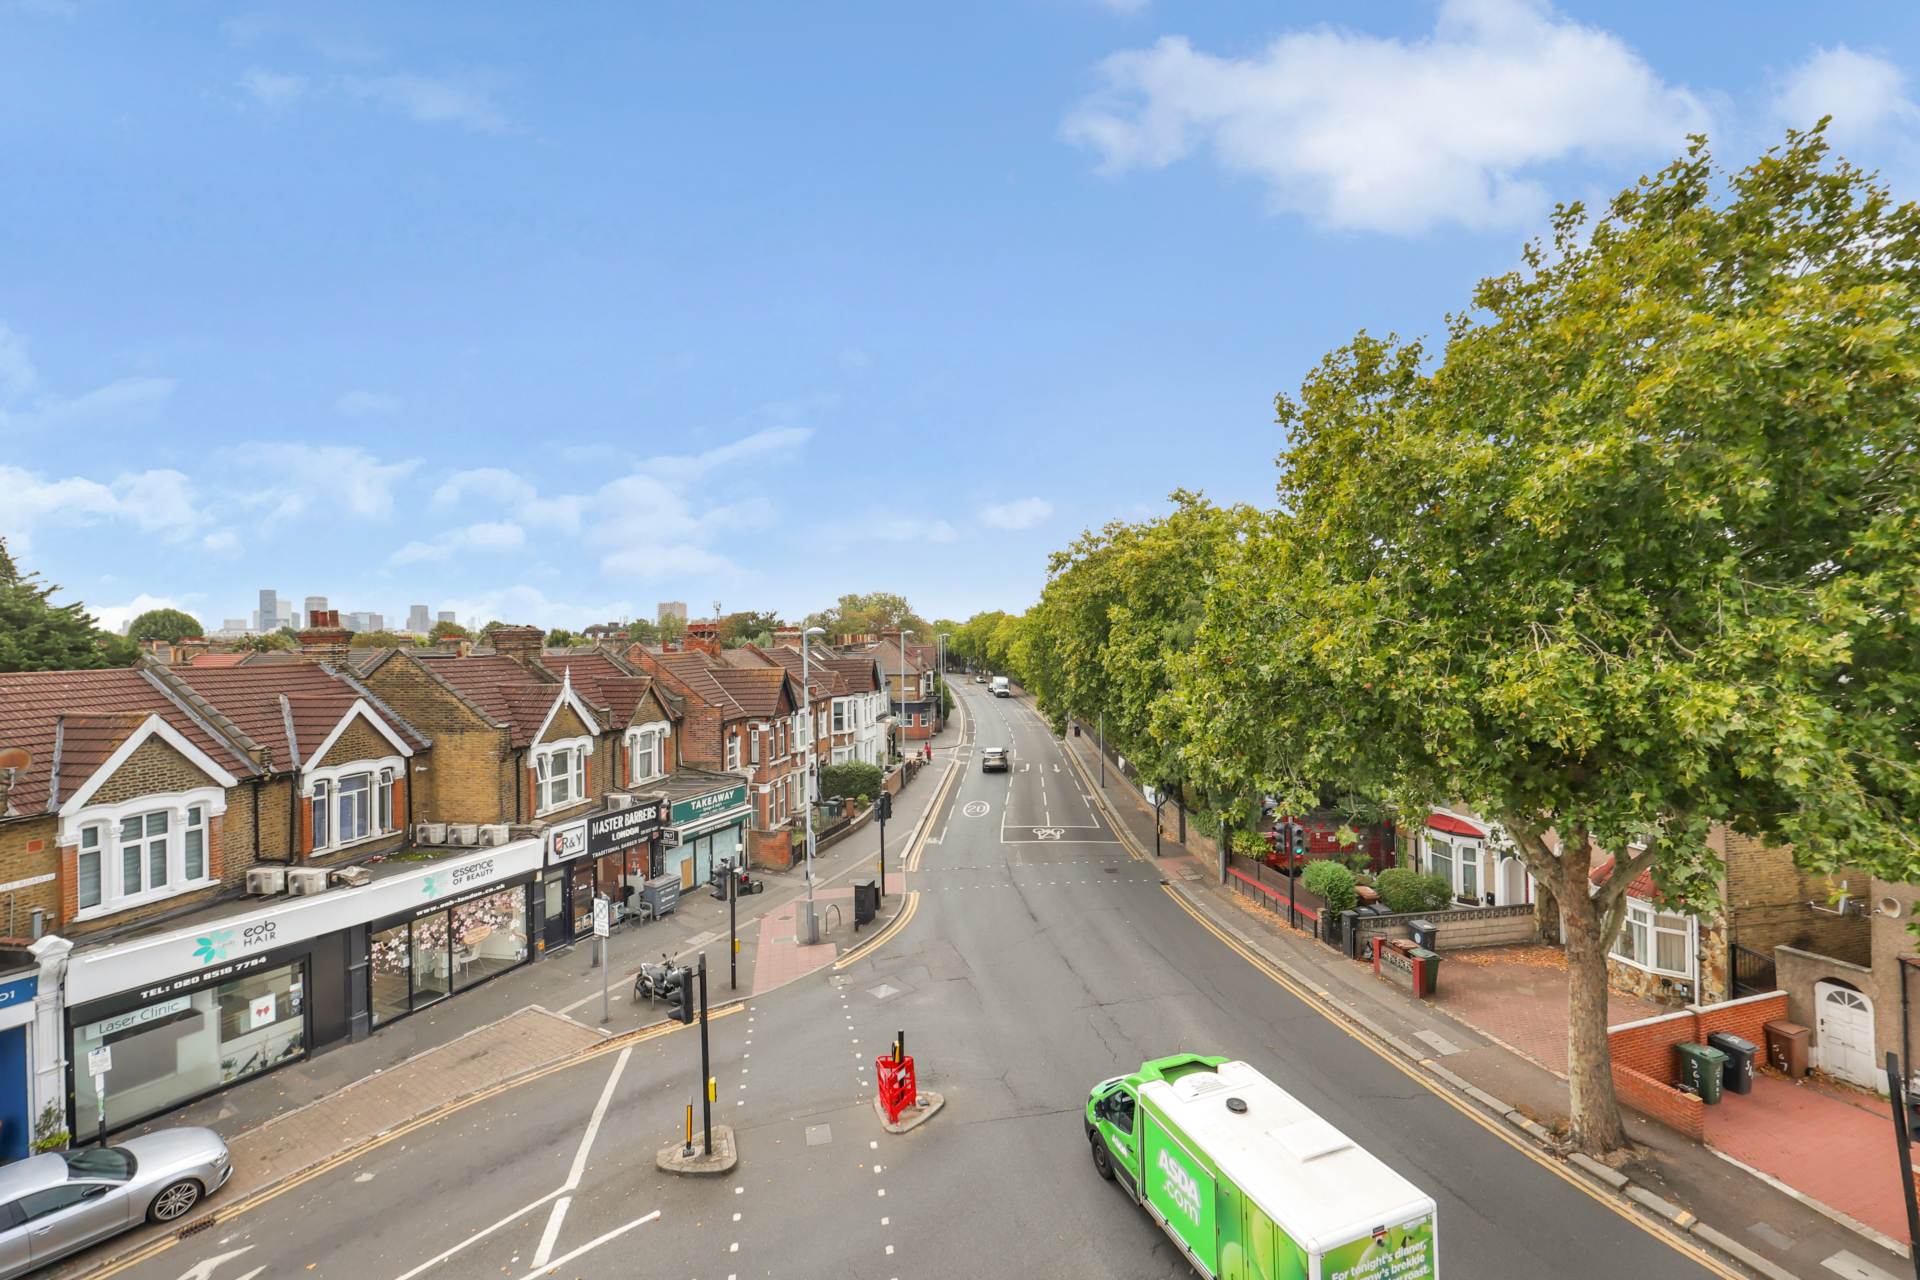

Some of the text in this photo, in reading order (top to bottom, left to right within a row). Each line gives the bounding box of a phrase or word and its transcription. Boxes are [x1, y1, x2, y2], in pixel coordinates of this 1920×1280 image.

[691, 790, 735, 810] TAKEAWAY
[967, 805, 985, 813] 20
[592, 815, 624, 837] MASTER
[624, 806, 657, 827] BARBERS
[612, 826, 640, 841] LONDON
[592, 846, 621, 859] TRADITIONAL
[621, 839, 638, 849] BARBER
[452, 859, 494, 878] essence
[452, 868, 494, 886] OF BEAUTY
[243, 920, 276, 938] eob
[243, 932, 276, 948] HAIR
[140, 985, 170, 999] TEL:
[173, 976, 200, 989] 020
[203, 966, 232, 980] 8518
[99, 1002, 180, 1034] Laser Clinic
[1159, 1148, 1201, 1209] ASDA
[1332, 1270, 1349, 1280] For
[1351, 1252, 1393, 1276] tonight's
